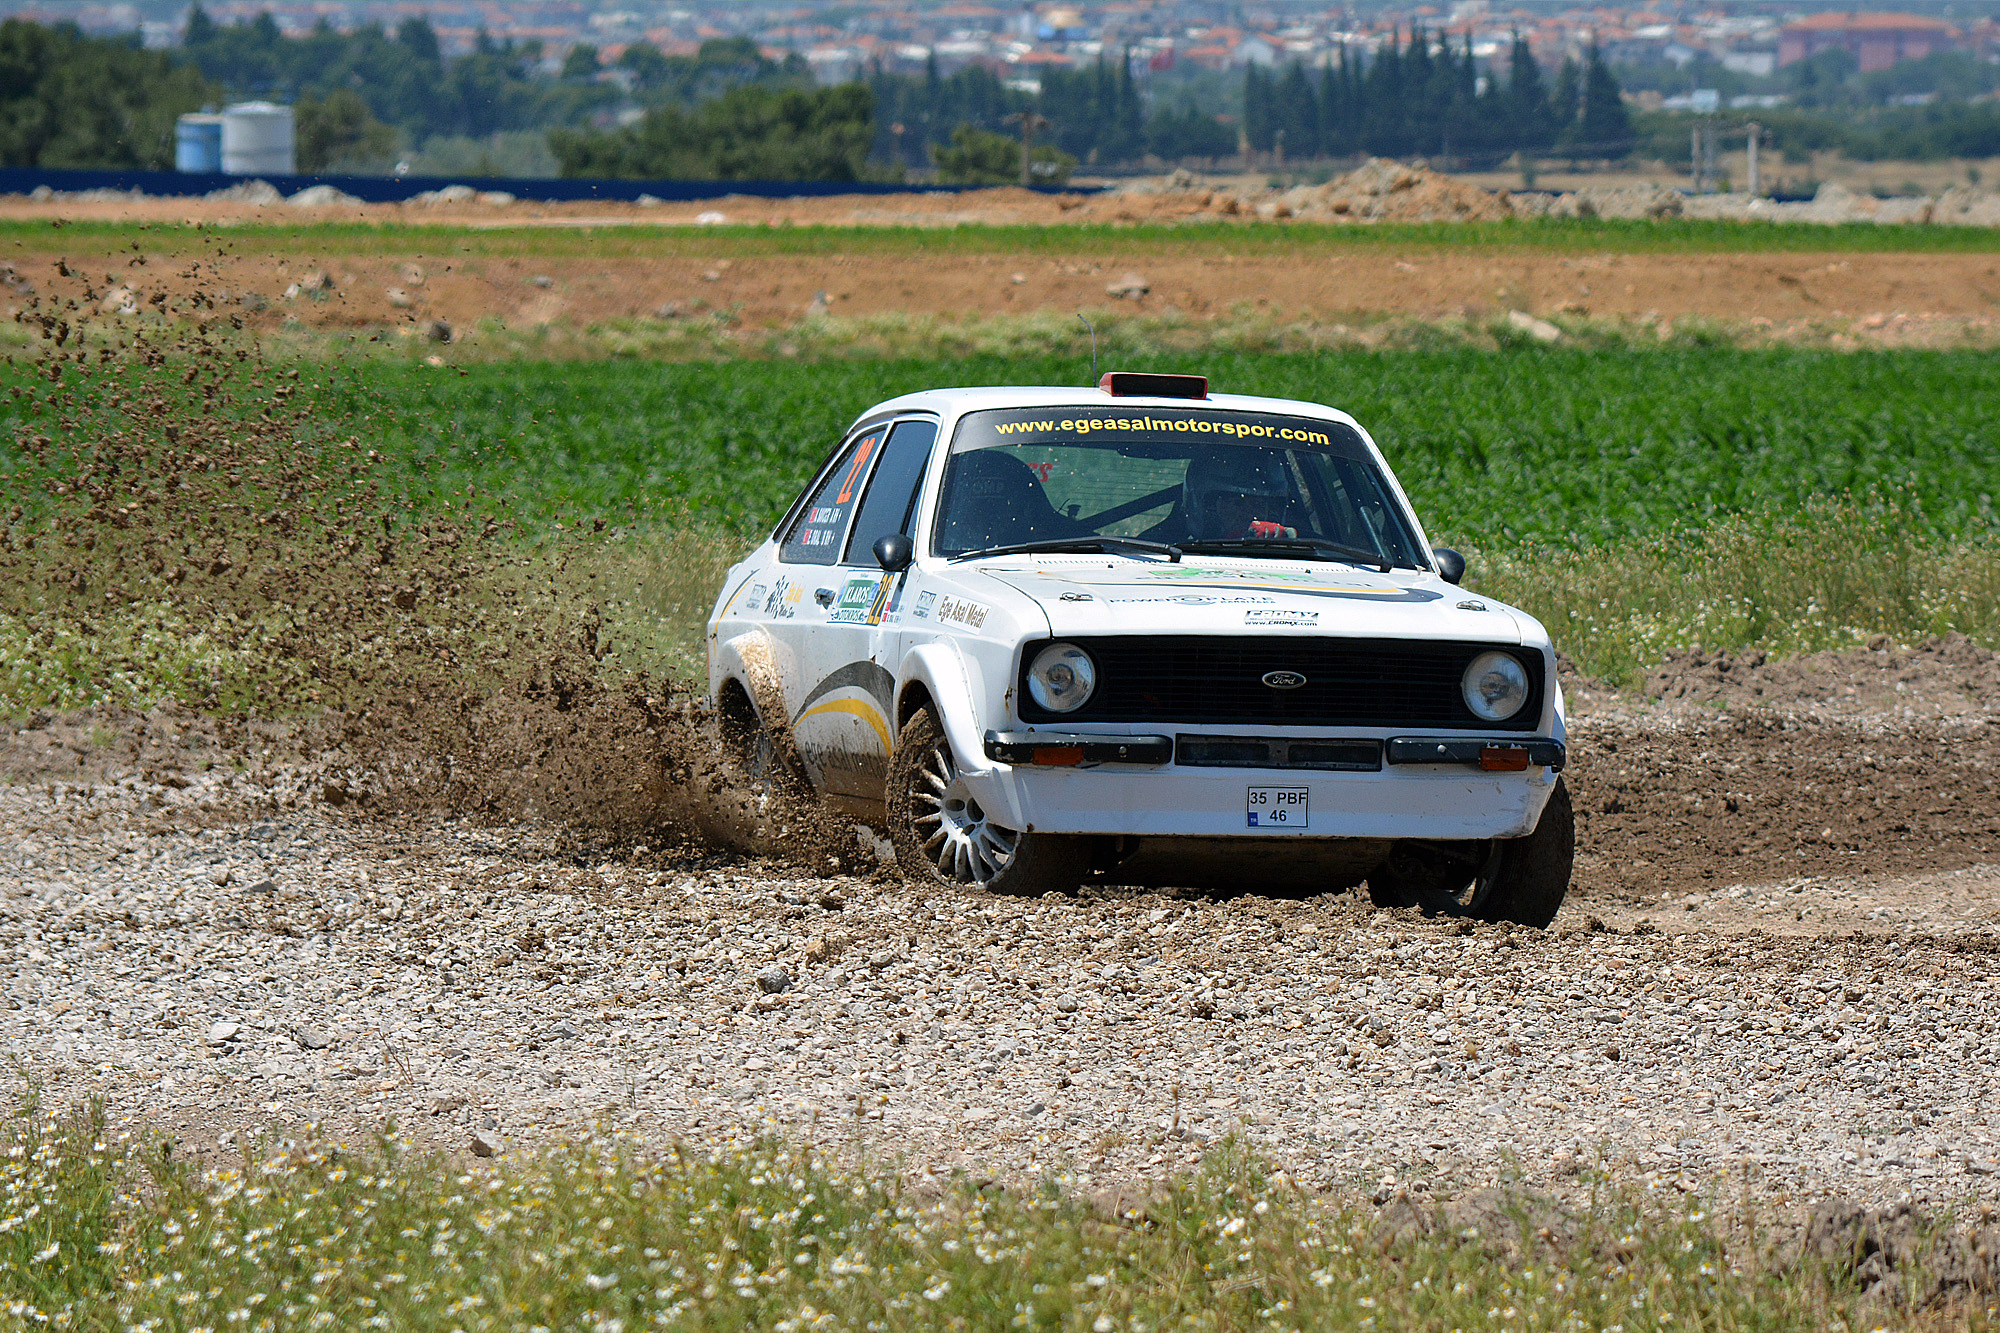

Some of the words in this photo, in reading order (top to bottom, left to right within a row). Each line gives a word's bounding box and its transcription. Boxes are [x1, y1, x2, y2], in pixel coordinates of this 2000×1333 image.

[995, 416, 1330, 445] www.egeasalmotorspor.com
[836, 437, 876, 504] 22
[867, 574, 893, 624] 22
[938, 596, 954, 622] Ege
[950, 600, 970, 622] Asal
[965, 603, 990, 628] Metal
[1271, 673, 1297, 685] Ford
[1249, 792, 1267, 804] 35
[1276, 792, 1307, 804] PBF
[1269, 809, 1287, 822] 46
